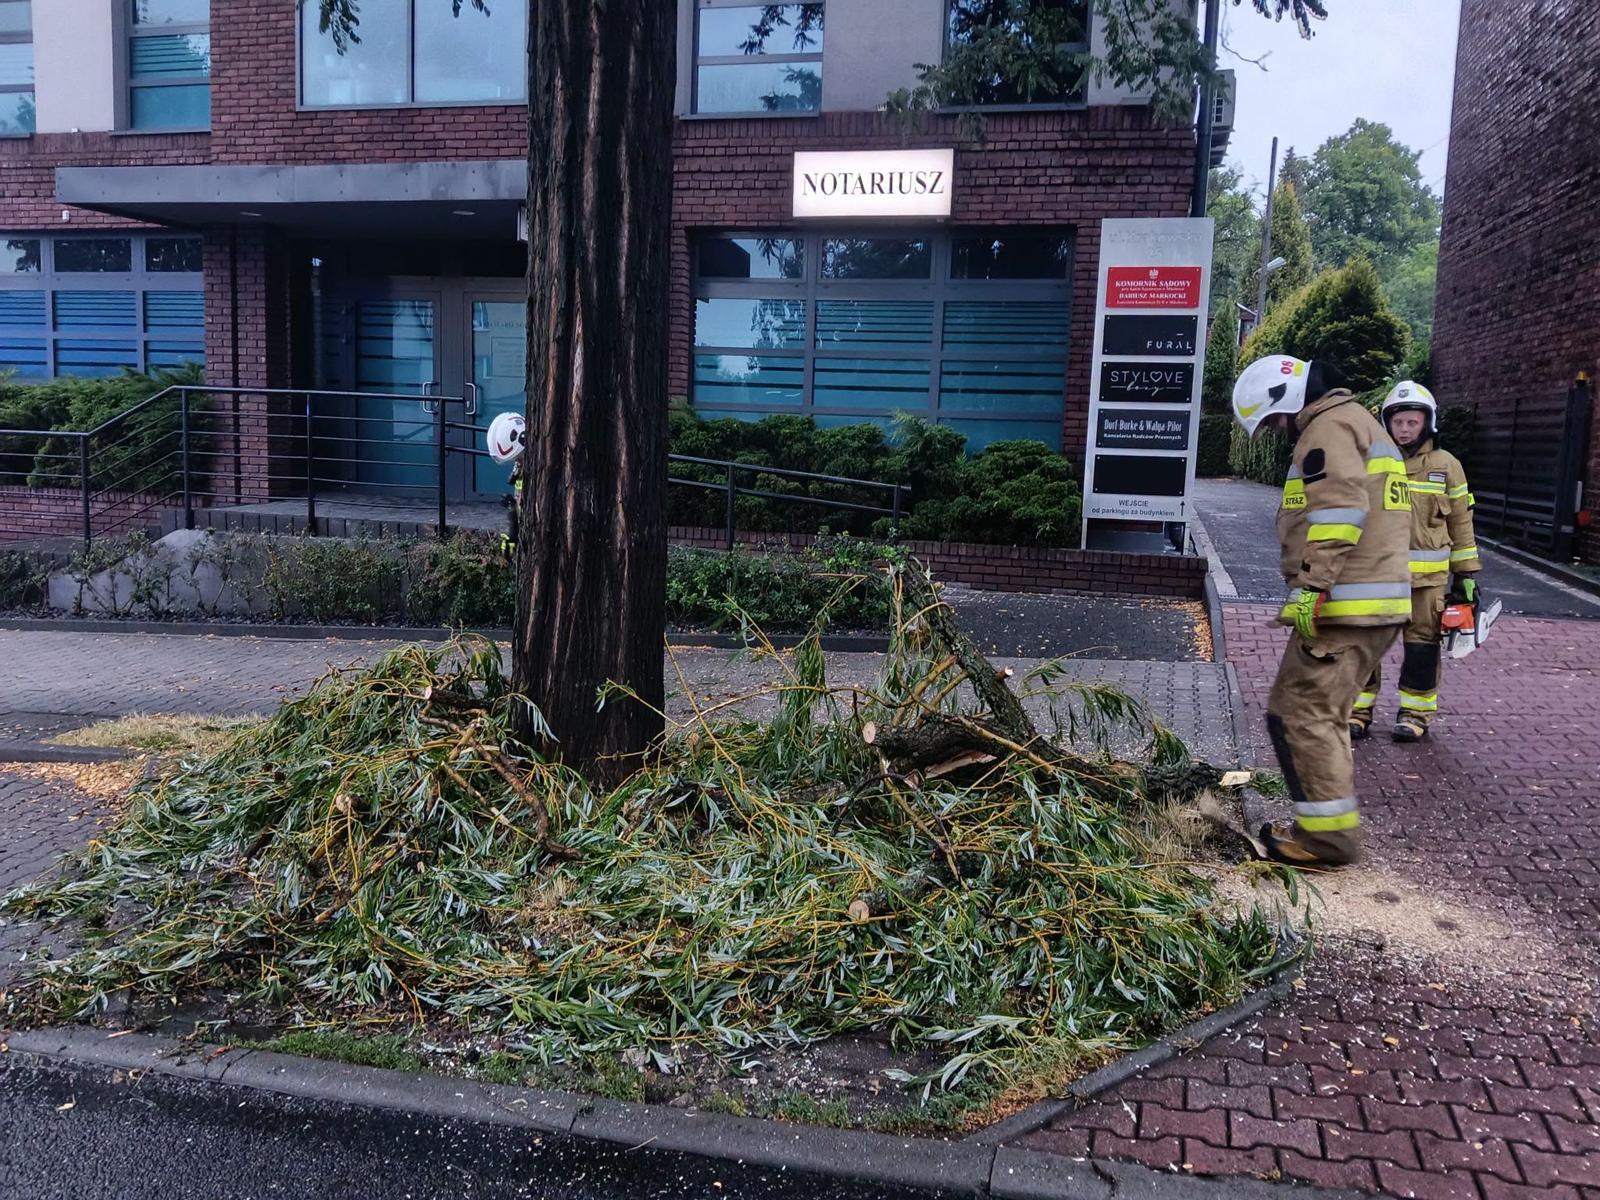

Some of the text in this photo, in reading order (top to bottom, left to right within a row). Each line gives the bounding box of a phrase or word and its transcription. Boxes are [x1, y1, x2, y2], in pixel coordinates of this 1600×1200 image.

[802, 171, 945, 196] NOTARIUSZ
[1159, 280, 1191, 288] SĄDOWY
[1138, 420, 1145, 431] &
[1118, 499, 1149, 507] WEJŚCIE
[1101, 508, 1129, 516] parkingu
[1139, 509, 1175, 517] budynkiem
